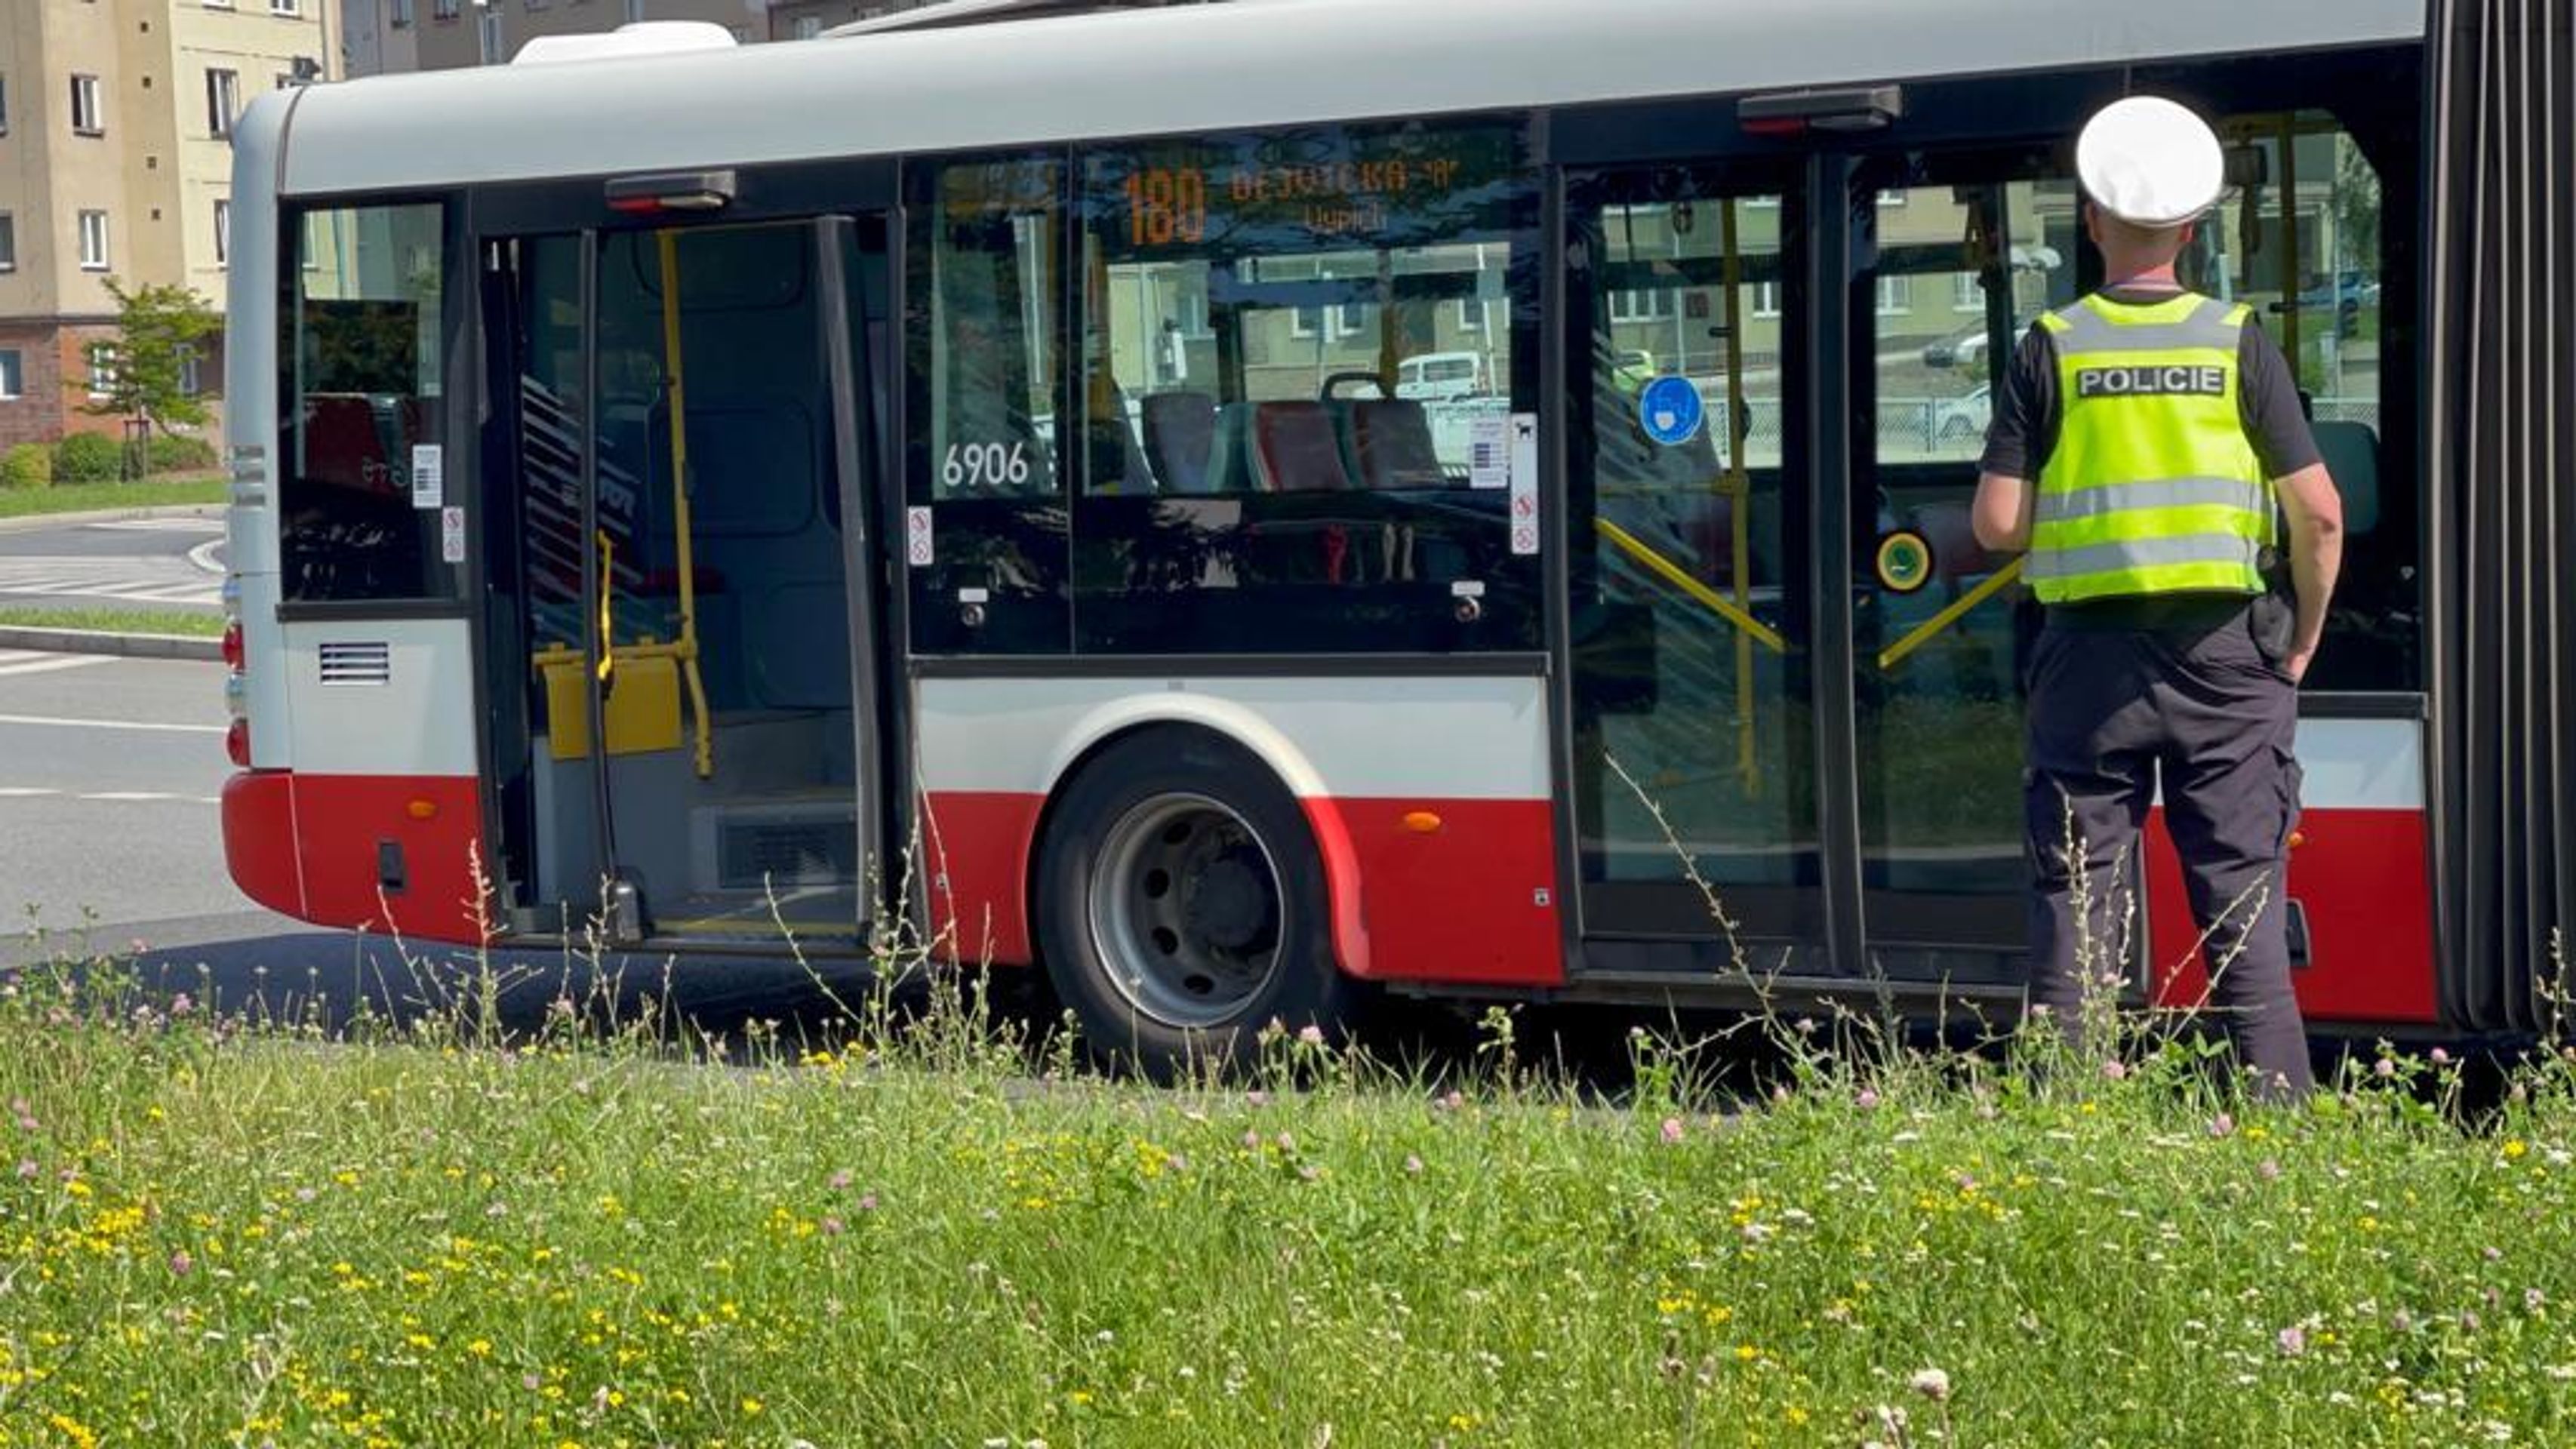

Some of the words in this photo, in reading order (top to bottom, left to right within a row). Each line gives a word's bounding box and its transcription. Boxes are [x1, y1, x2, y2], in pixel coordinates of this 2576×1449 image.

[1125, 164, 1203, 245] 180
[2080, 368, 2222, 395] POLICIE
[943, 442, 1027, 486] 6906
